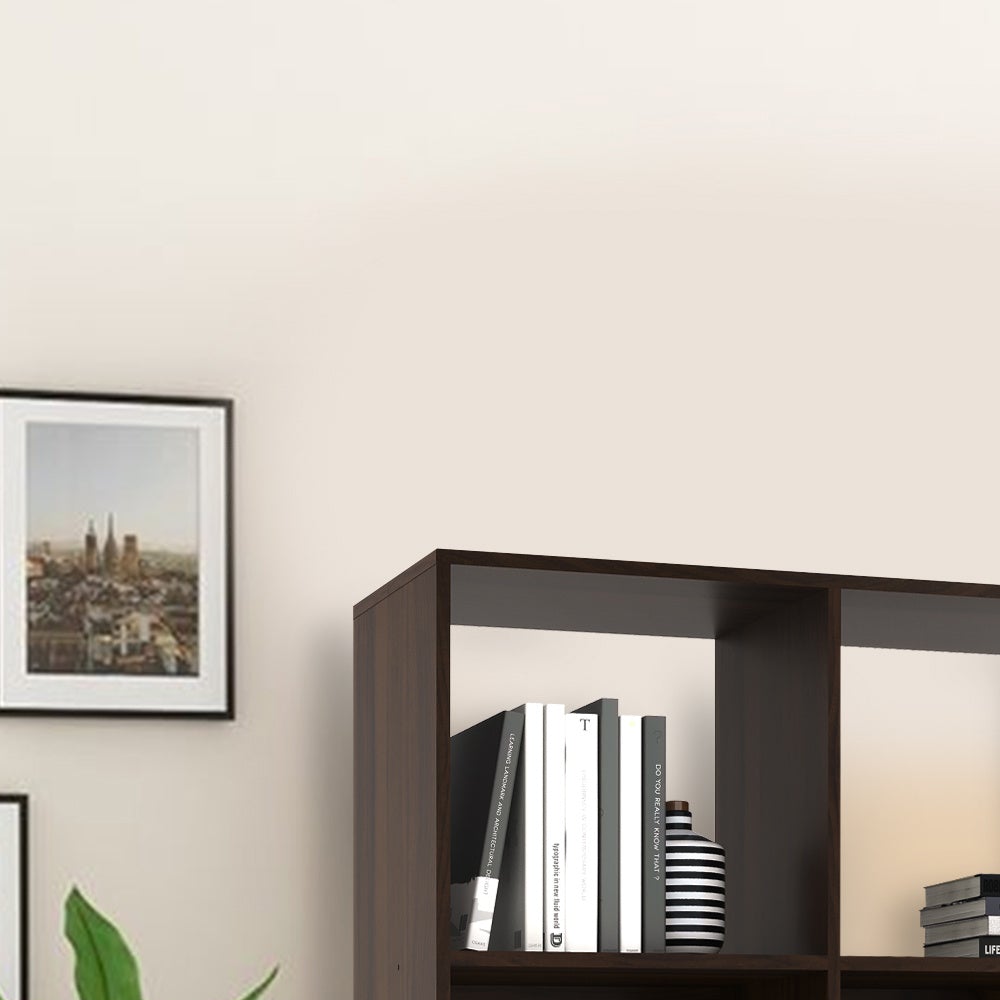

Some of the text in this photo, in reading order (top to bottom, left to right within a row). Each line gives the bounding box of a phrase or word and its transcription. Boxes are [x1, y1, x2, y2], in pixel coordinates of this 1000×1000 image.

[580, 718, 590, 732] T
[655, 764, 662, 776] DO
[499, 766, 510, 800] LANDMARK
[496, 802, 504, 816] AND
[985, 945, 1000, 955] LIFE
